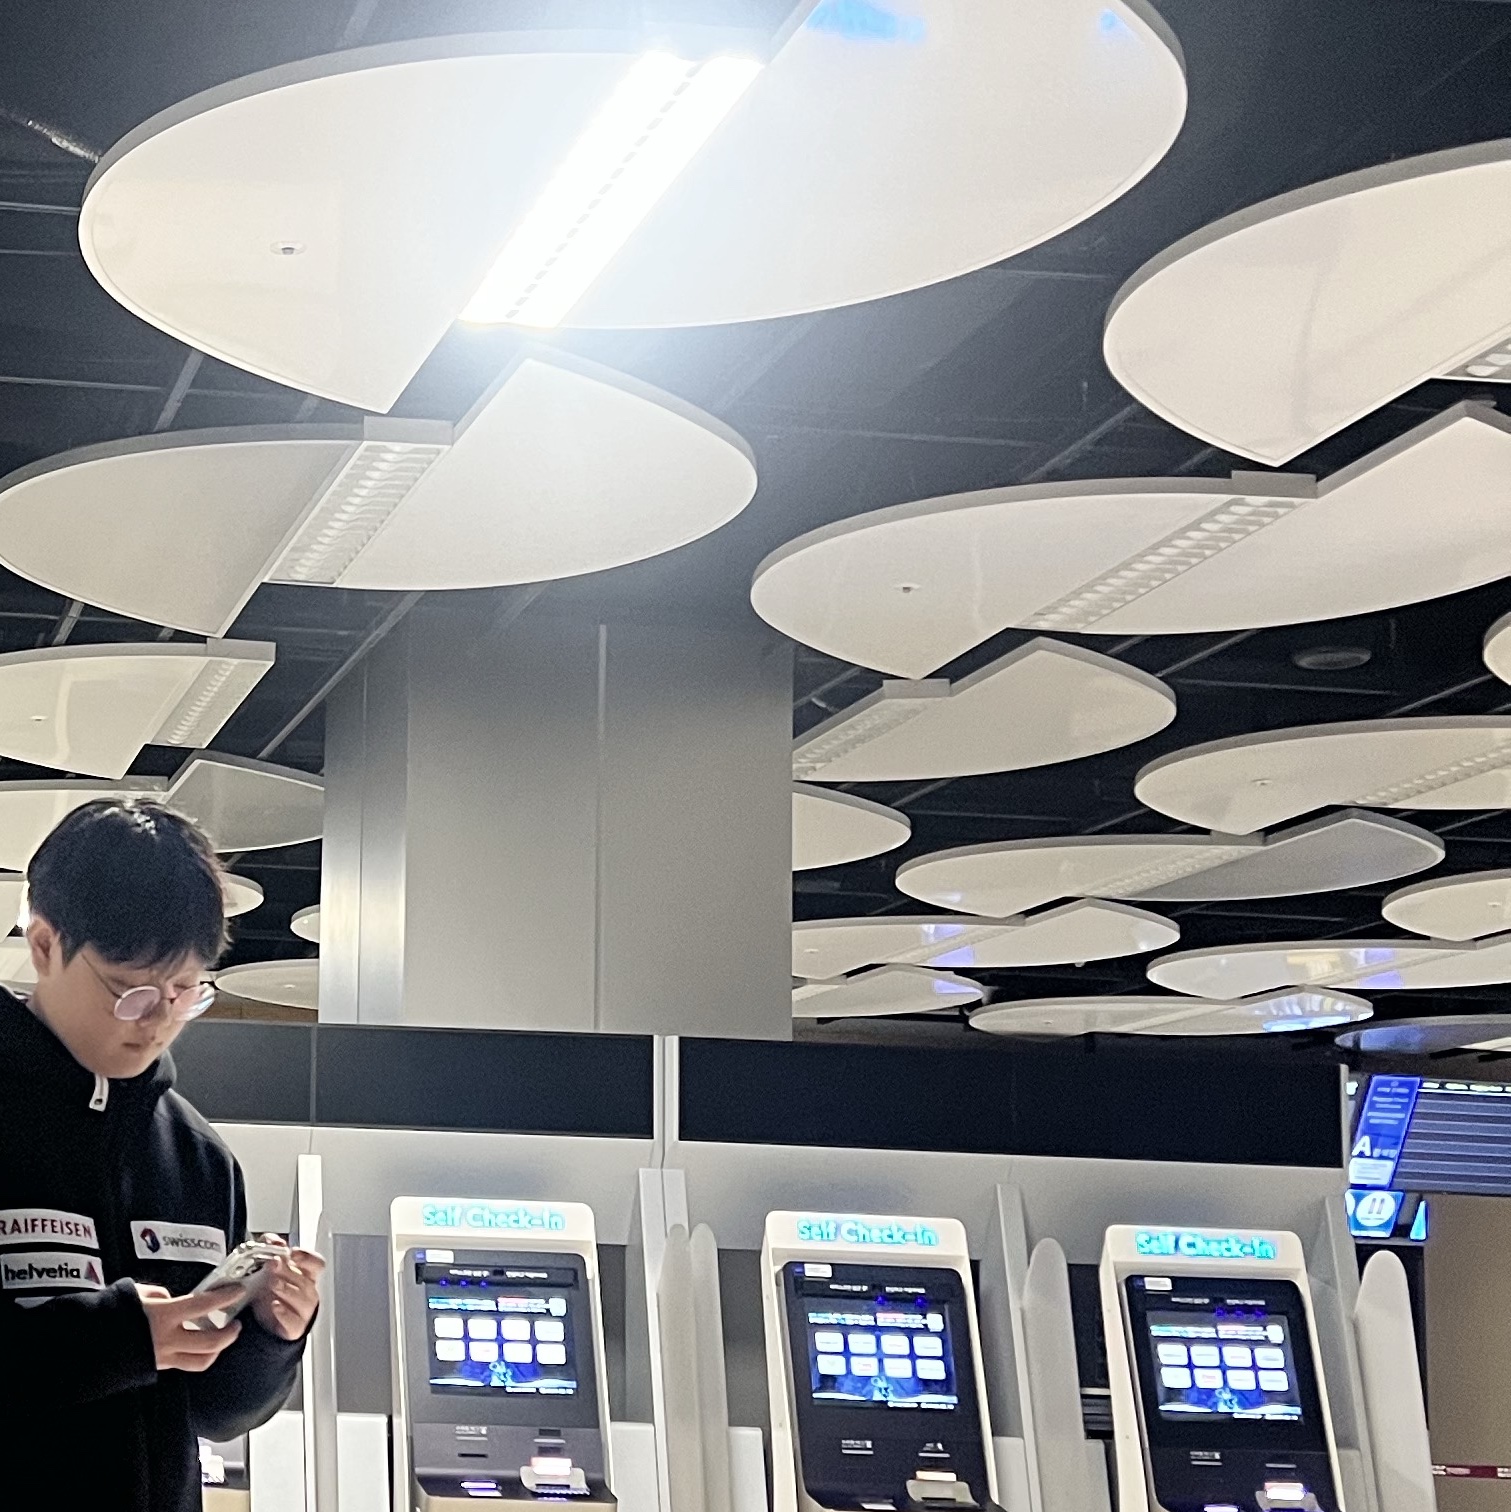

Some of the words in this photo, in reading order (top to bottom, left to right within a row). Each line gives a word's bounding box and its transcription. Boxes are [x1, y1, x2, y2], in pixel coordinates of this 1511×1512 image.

[423, 1205, 463, 1227] Self
[467, 1205, 566, 1231] Check-In
[163, 1233, 221, 1250] swisscom
[797, 1220, 837, 1242] Self
[840, 1221, 938, 1246] Check-In
[4, 1262, 80, 1281] helvetia
